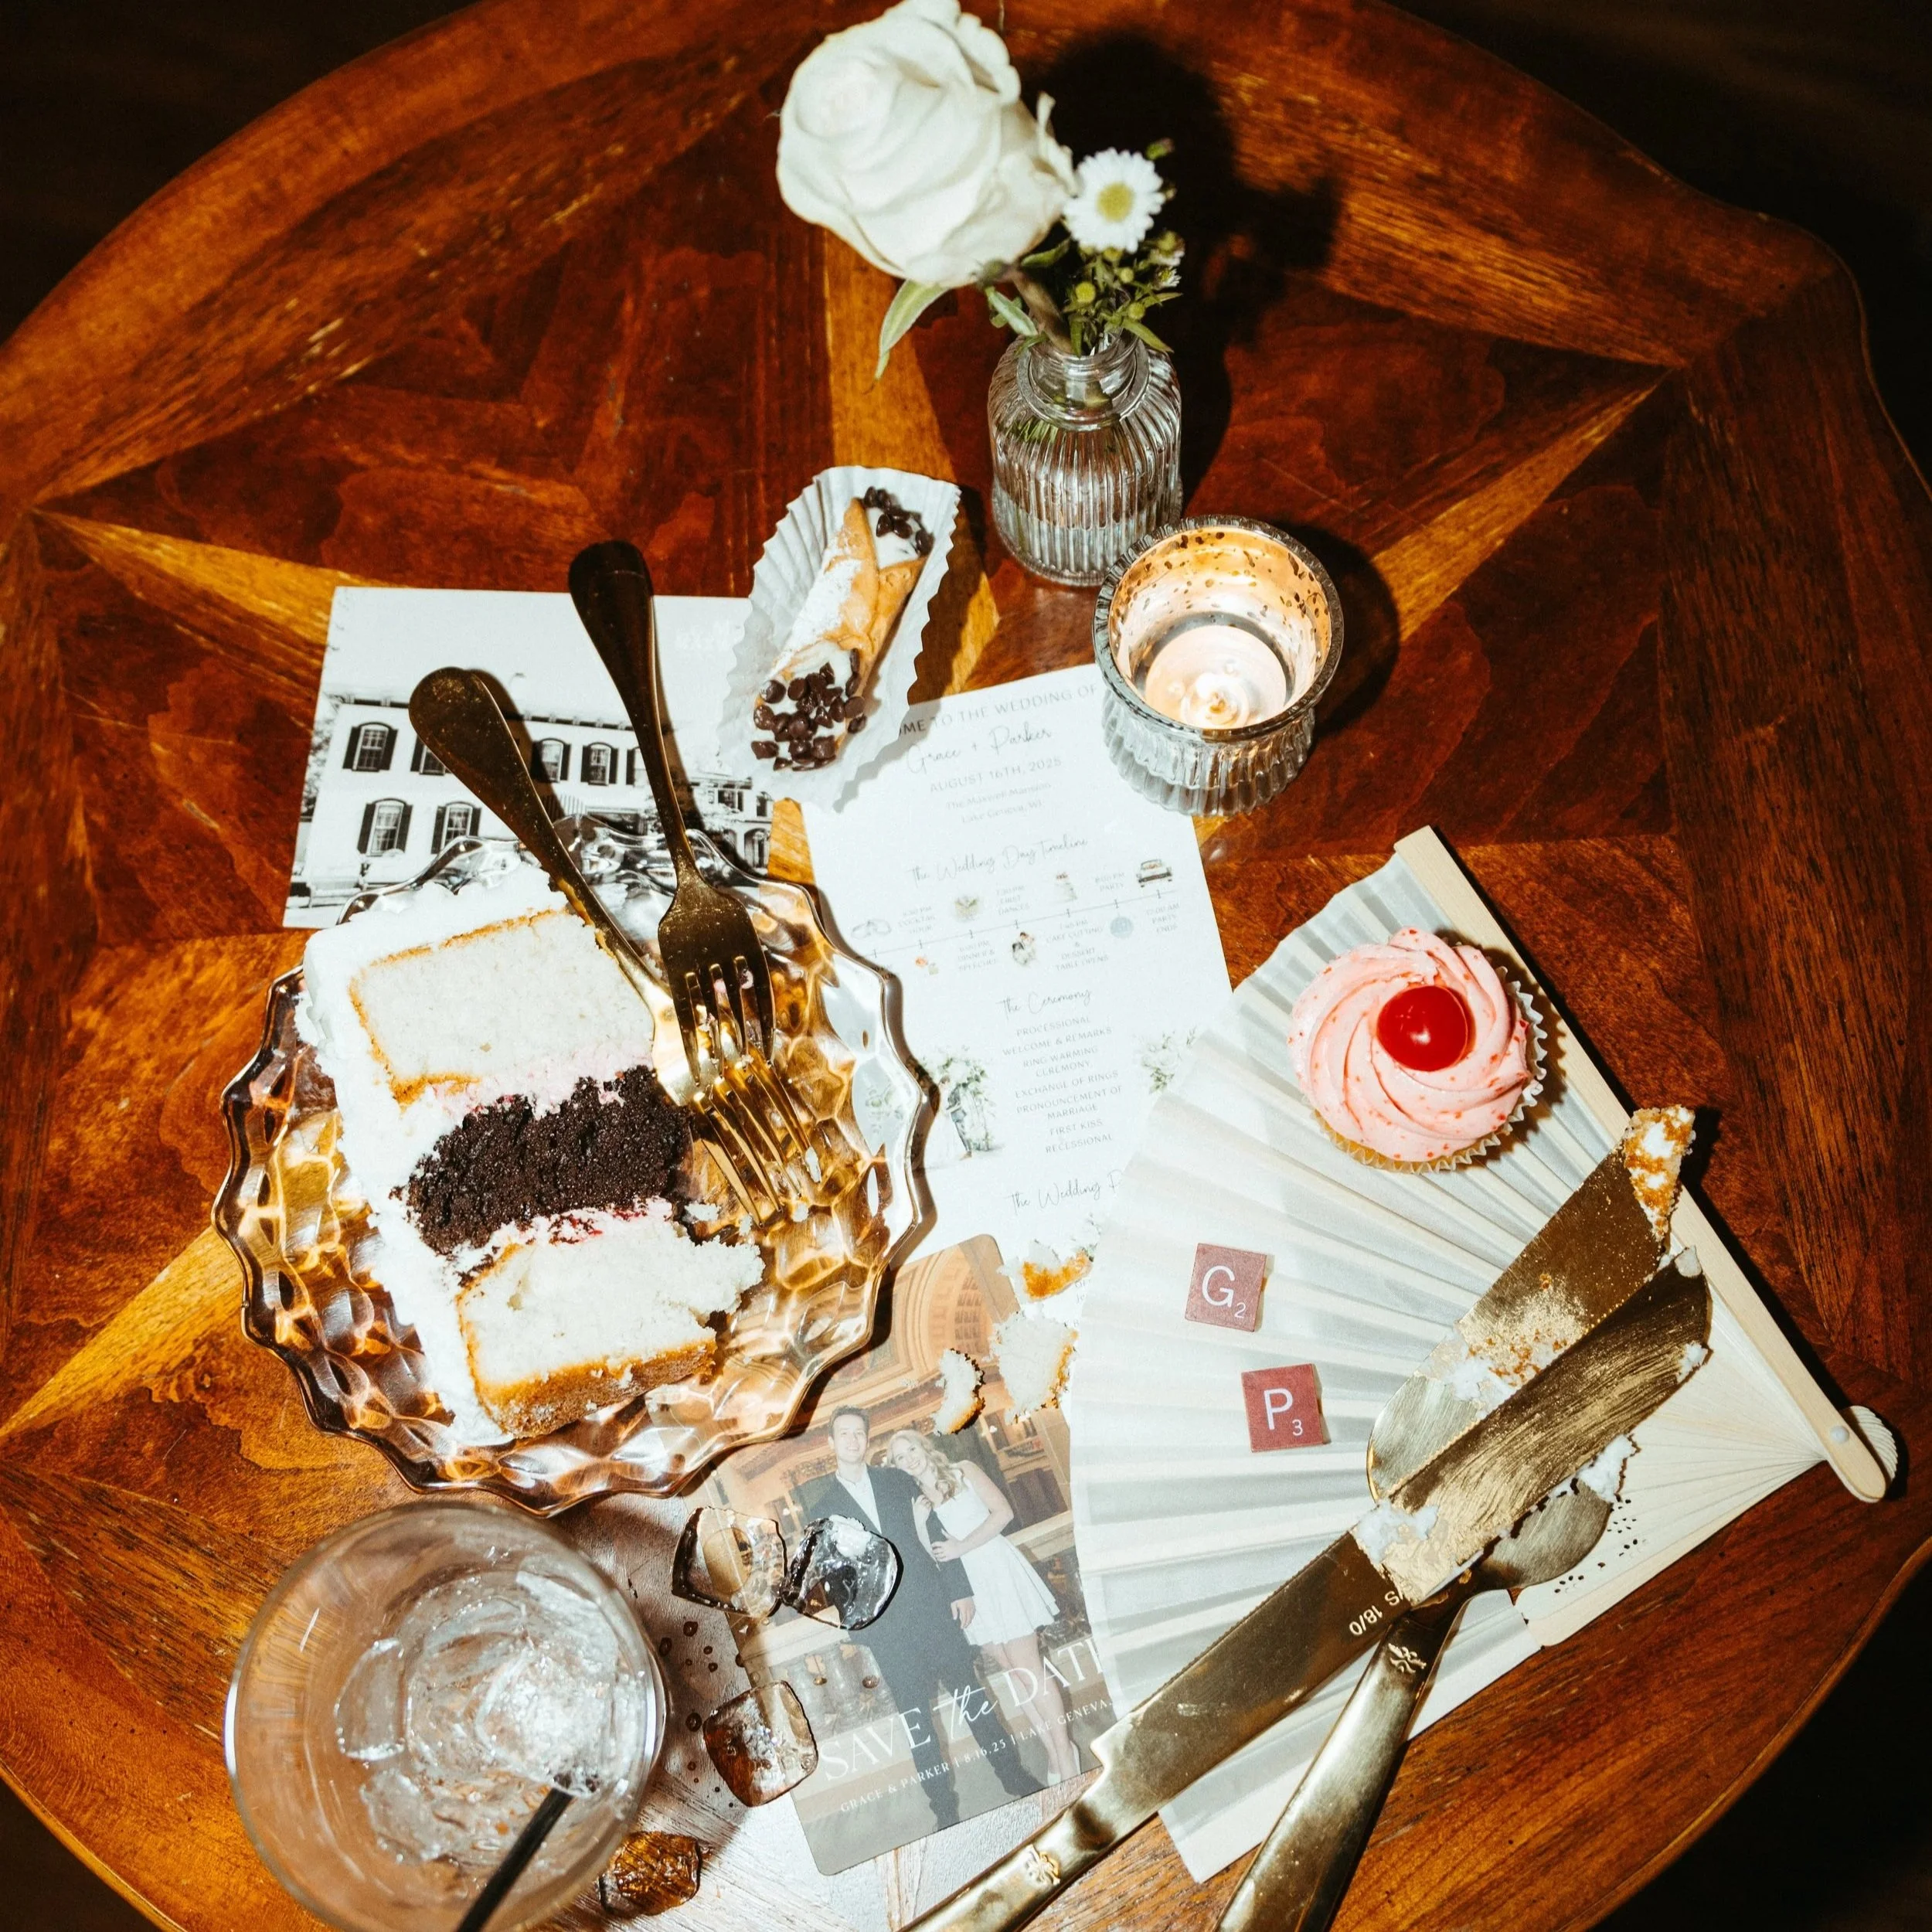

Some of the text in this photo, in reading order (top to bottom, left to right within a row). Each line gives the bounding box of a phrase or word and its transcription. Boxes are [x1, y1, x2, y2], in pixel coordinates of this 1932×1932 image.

[930, 713, 953, 729] TO
[960, 706, 989, 723] THE
[994, 691, 1073, 715] WEDDING
[1077, 683, 1097, 698] OF
[906, 744, 961, 775] Grace
[989, 721, 1052, 755] Parker
[930, 771, 983, 793] AUGUST
[1029, 757, 1062, 772] 2025
[937, 853, 995, 882] Wedding
[1002, 845, 1037, 870] Day
[1032, 834, 1089, 860] Timeline
[1028, 989, 1092, 1015] Ceremony
[1002, 1026, 1113, 1056] WELCOME & REMARKS
[1015, 1015, 1092, 1037] PROCESSIONAL
[1022, 1046, 1098, 1068] RING WARMING
[1015, 1070, 1119, 1100] EXCHANGE OF RINGS
[1016, 1084, 1123, 1114] PRONOUNCEMENT OF
[1047, 1102, 1097, 1120] MARRIAGE
[1049, 1118, 1104, 1136] FIRST KISS
[1045, 1133, 1113, 1153] RECESSIONAL
[1038, 1178, 1101, 1209] Wedding
[1349, 1605, 1383, 1636] 18/0
[820, 1707, 931, 1781] SAVE
[933, 1685, 998, 1740] the
[841, 1789, 884, 1812] GRACE
[889, 1784, 898, 1794] &
[900, 1762, 950, 1789] PARKER
[964, 1739, 1006, 1764] 8.16.25
[1019, 1721, 1052, 1740] LAKE
